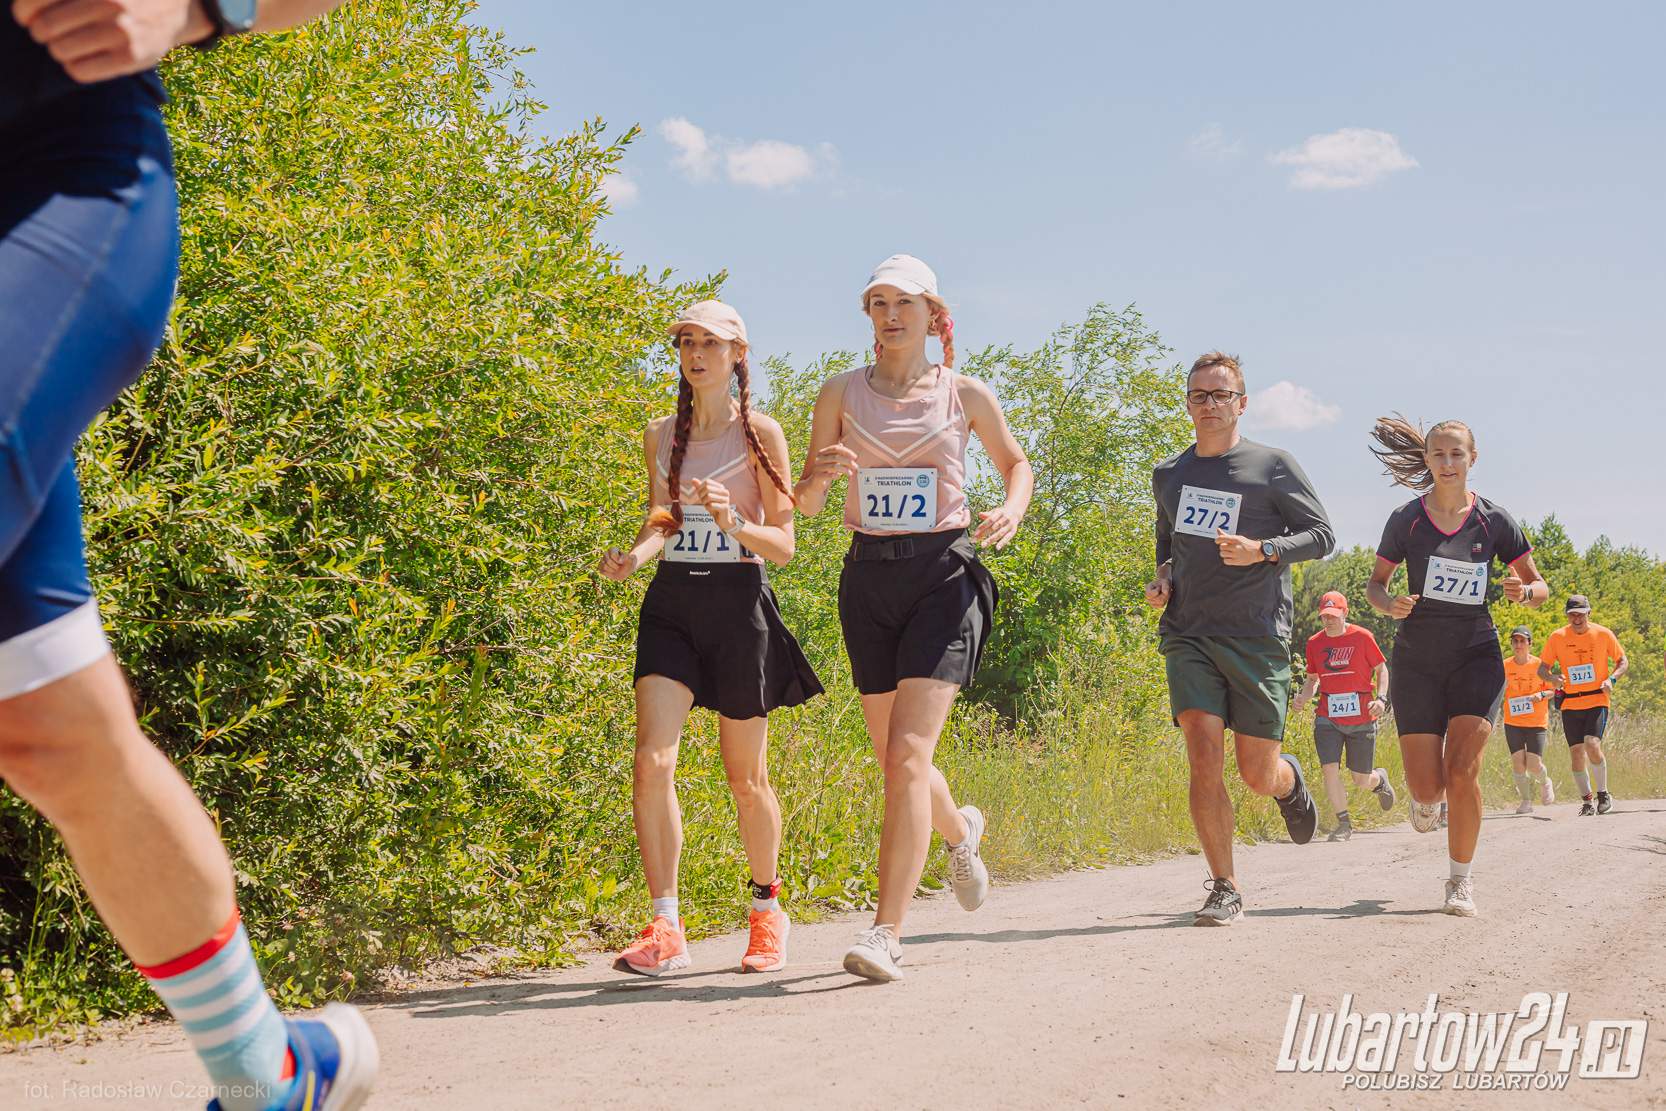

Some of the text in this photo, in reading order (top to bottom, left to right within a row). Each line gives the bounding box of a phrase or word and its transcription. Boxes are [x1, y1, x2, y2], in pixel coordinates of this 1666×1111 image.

[866, 493, 927, 519] 21/2
[1183, 505, 1231, 531] 27/2
[673, 529, 730, 553] 21/1
[1432, 575, 1479, 597] 27/1
[1329, 646, 1355, 662] RUN
[1572, 671, 1593, 681] 31/1
[1331, 702, 1357, 713] 24/1
[1511, 702, 1531, 713] 31/2
